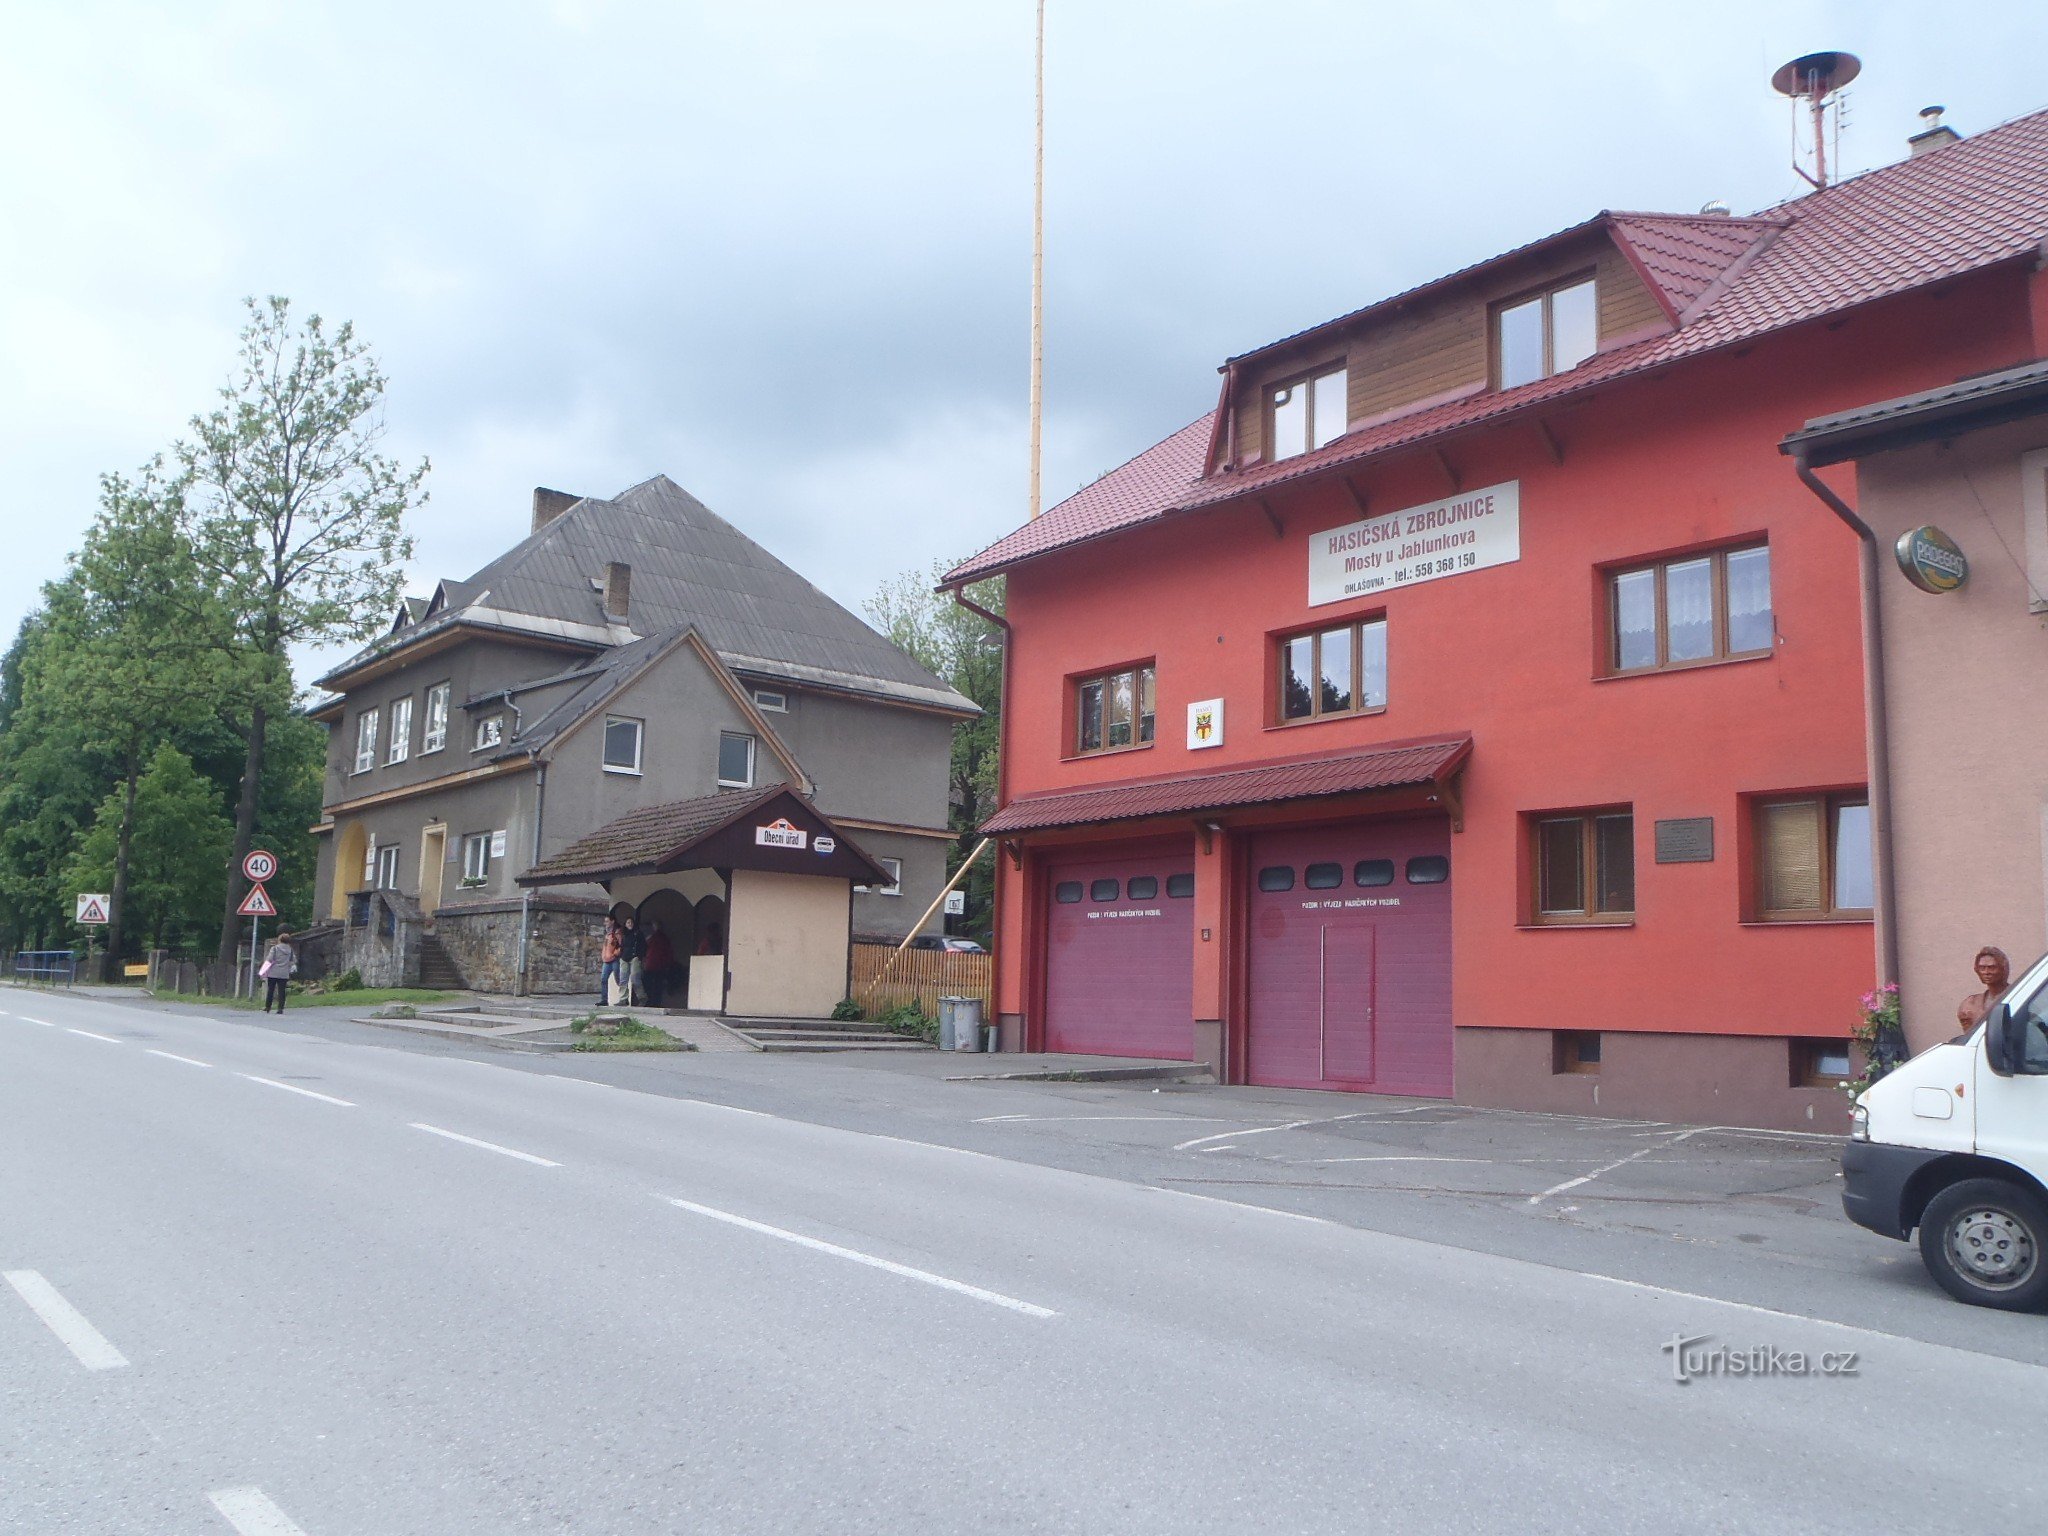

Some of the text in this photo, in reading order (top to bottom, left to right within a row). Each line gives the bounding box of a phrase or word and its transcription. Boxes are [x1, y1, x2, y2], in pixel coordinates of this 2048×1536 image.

[1328, 495, 1495, 555] HASIČSKÁ ZBROJNICE
[1345, 529, 1476, 574] Mosty u Jablunkova
[1344, 576, 1385, 595] OHLAŠOVNA
[1394, 568, 1413, 583] tel.:
[1415, 560, 1433, 578] 558
[1435, 556, 1454, 574] 368
[1457, 552, 1476, 569] 150
[764, 830, 799, 845] Obecní úřad
[250, 859, 269, 873] 40
